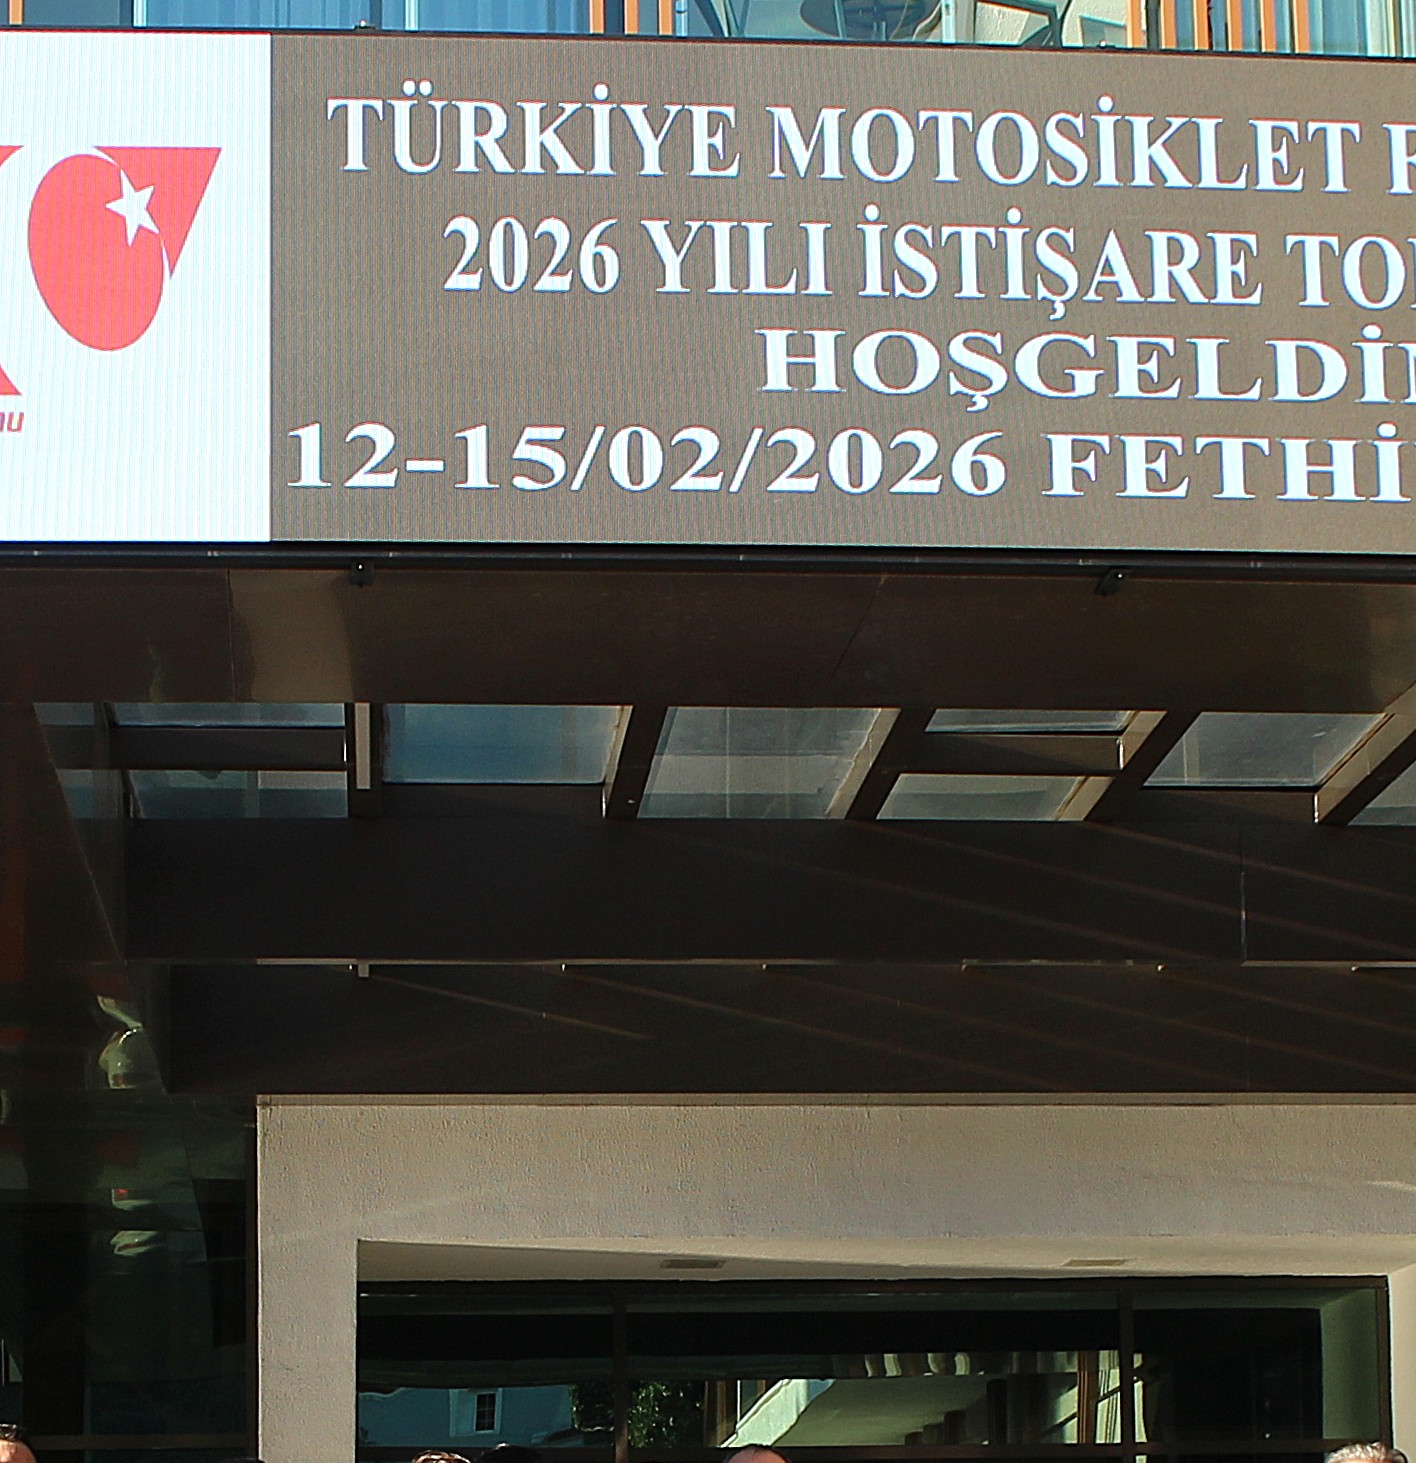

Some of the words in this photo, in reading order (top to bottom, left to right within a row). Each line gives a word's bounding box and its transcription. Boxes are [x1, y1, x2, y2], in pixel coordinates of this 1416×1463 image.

[327, 80, 741, 177] TÜRKİYE
[765, 95, 1361, 192] MOTOSİKLET
[443, 216, 620, 293] 2026
[640, 219, 834, 295] YILI
[856, 204, 1263, 321] İSTİŞARE
[286, 422, 1008, 497] 12-15/02/2026
